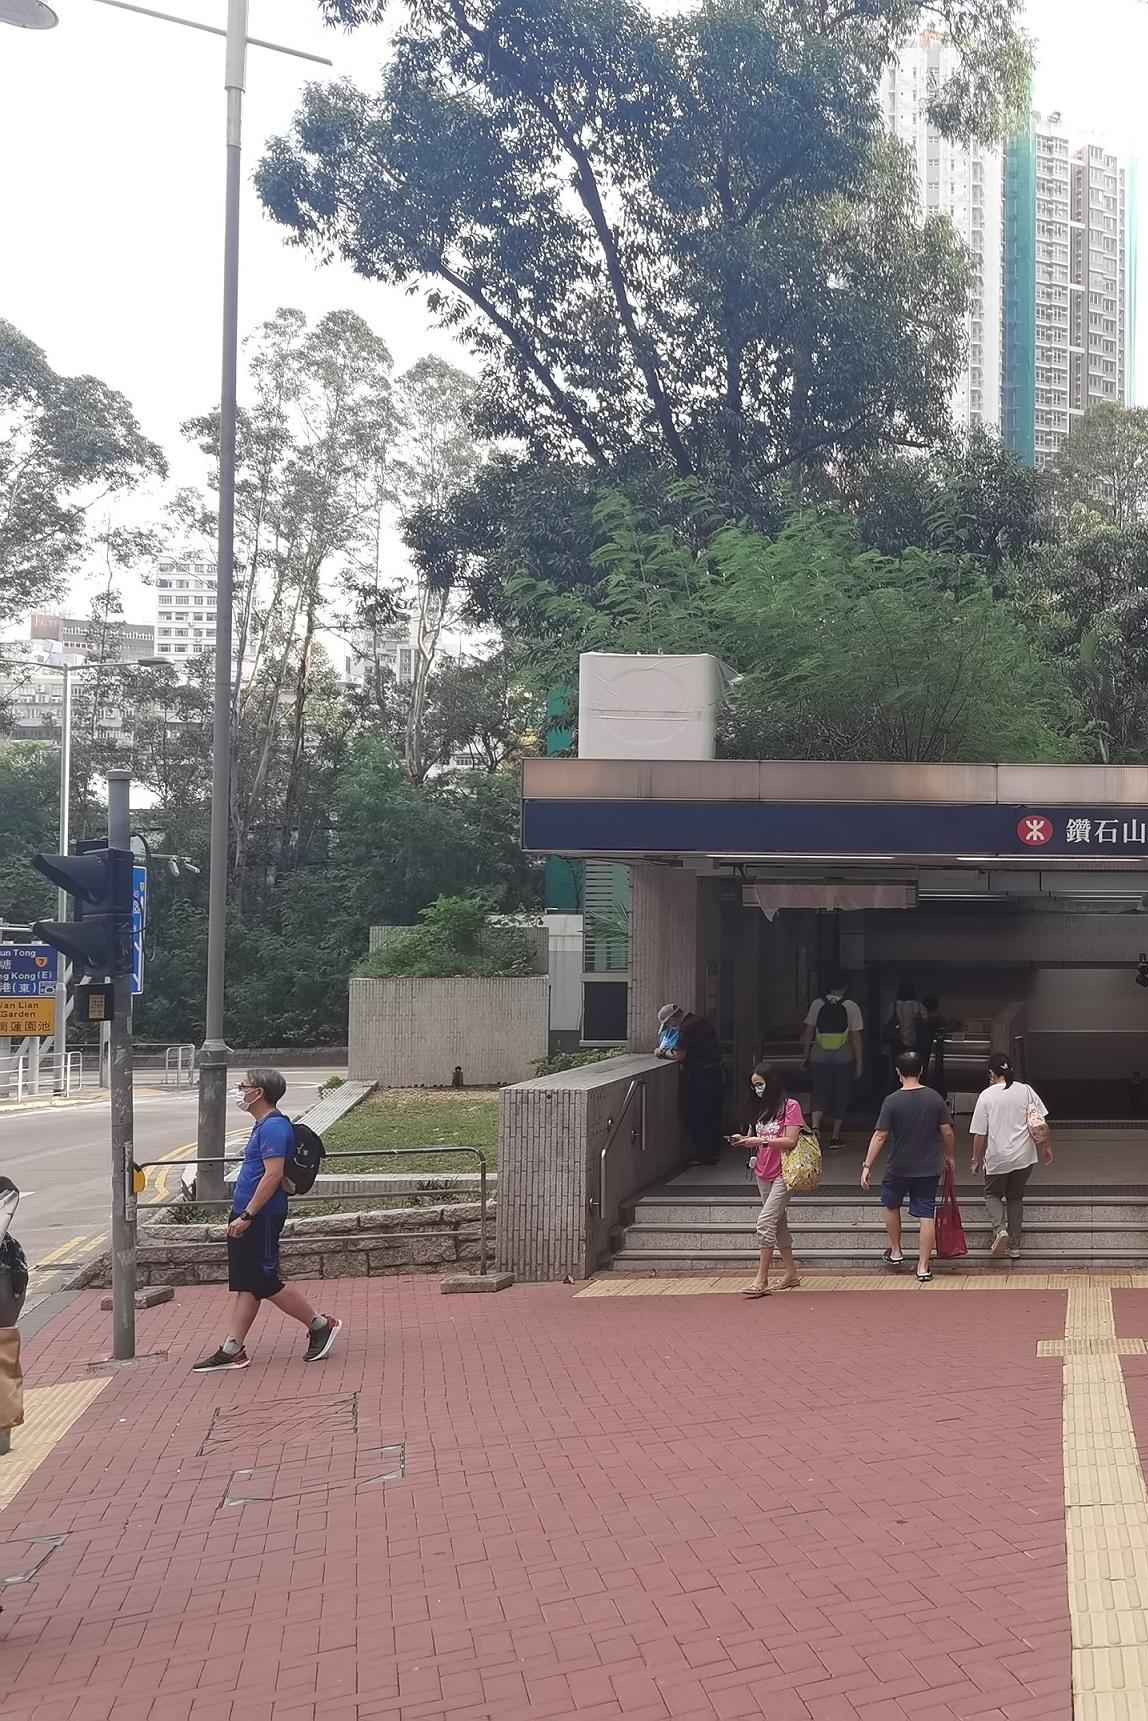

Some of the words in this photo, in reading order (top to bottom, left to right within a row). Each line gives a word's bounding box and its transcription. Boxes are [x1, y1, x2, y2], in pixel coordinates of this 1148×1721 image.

[13, 949, 36, 958] Tong
[11, 972, 36, 981] Kong
[38, 971, 52, 979] (E)
[18, 1001, 39, 1009] Lian
[0, 1010, 36, 1018] Garden
